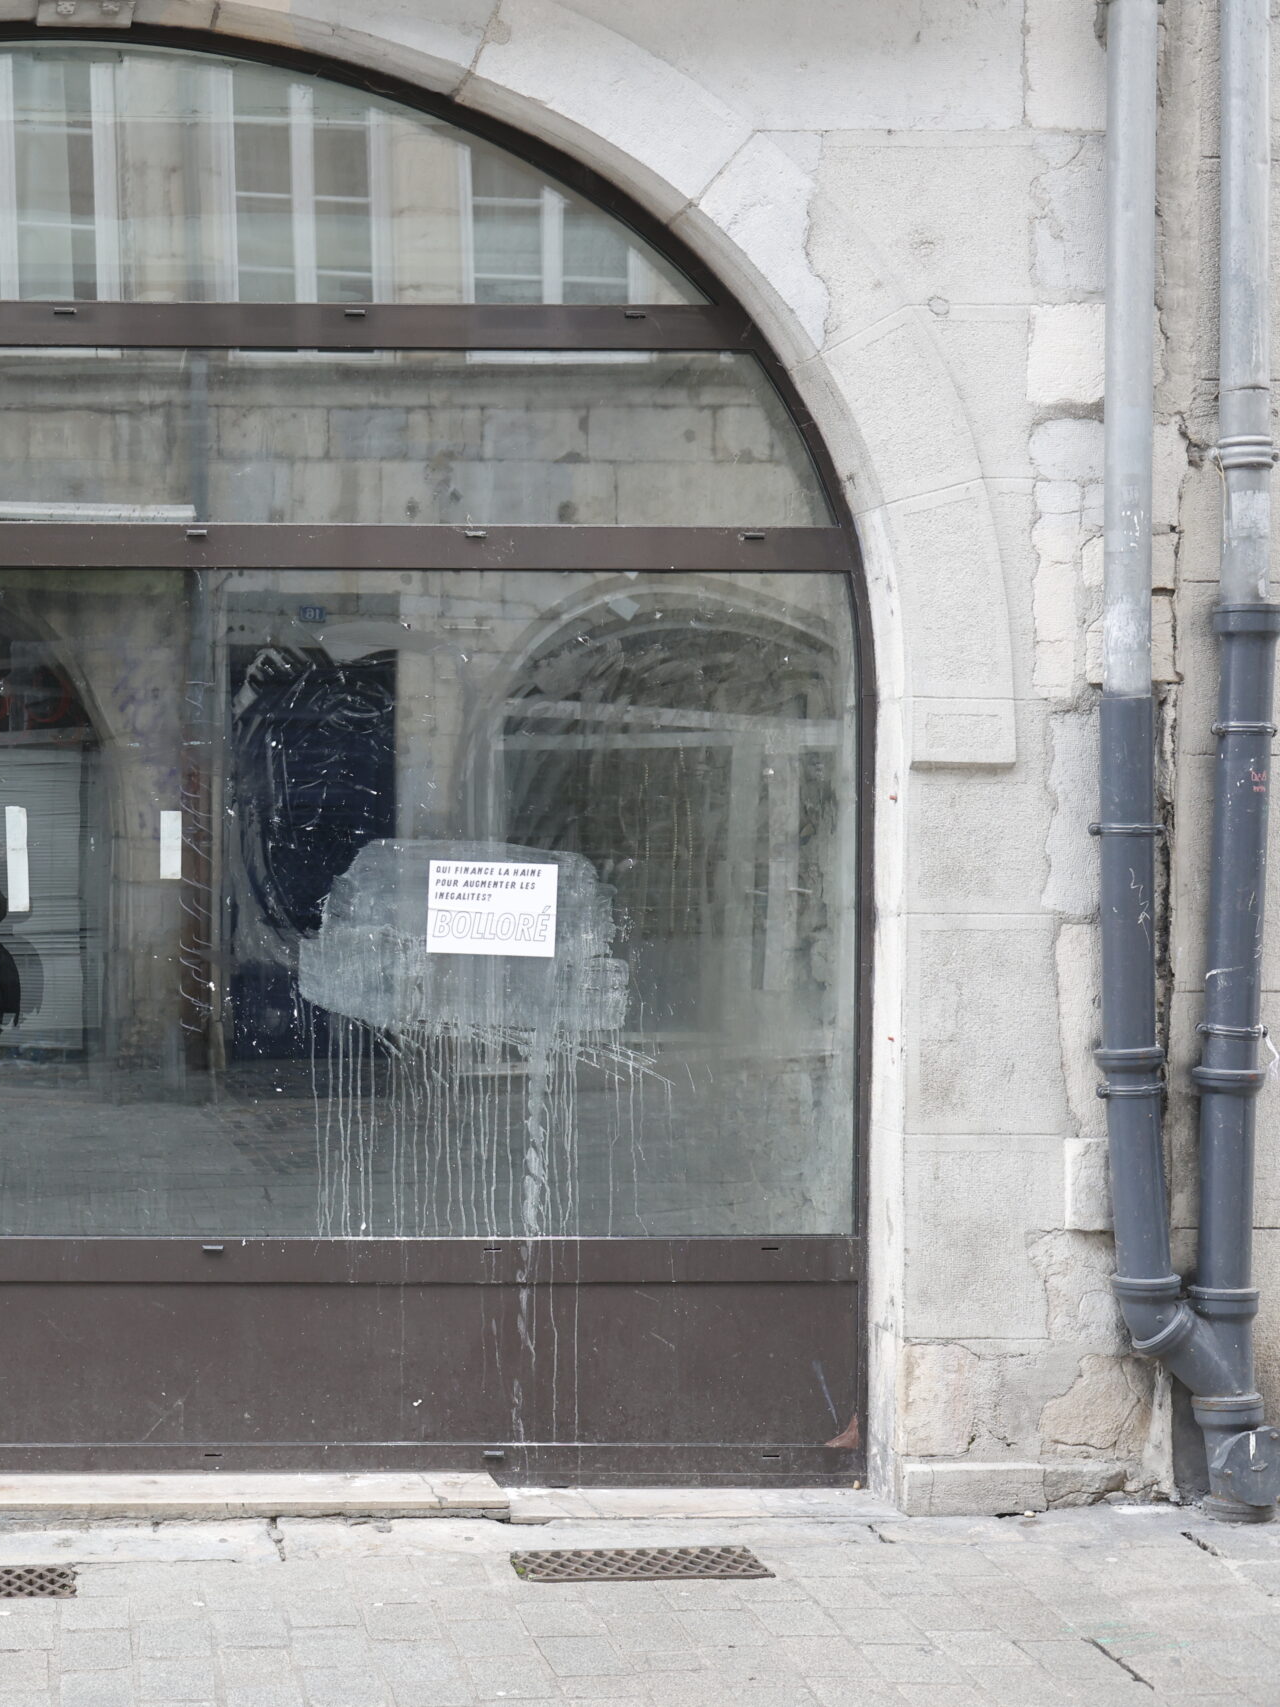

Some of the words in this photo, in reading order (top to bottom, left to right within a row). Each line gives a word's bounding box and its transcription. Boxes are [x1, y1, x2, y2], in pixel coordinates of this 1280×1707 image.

[435, 865, 451, 874] QUI
[454, 866, 495, 876] FINANCE
[498, 867, 510, 876] LA
[513, 868, 542, 877] HAINE
[435, 878, 459, 887] POUR
[462, 879, 517, 889] AUGMENTER
[520, 881, 536, 890] LES
[432, 905, 551, 942] BOLLORÉ
